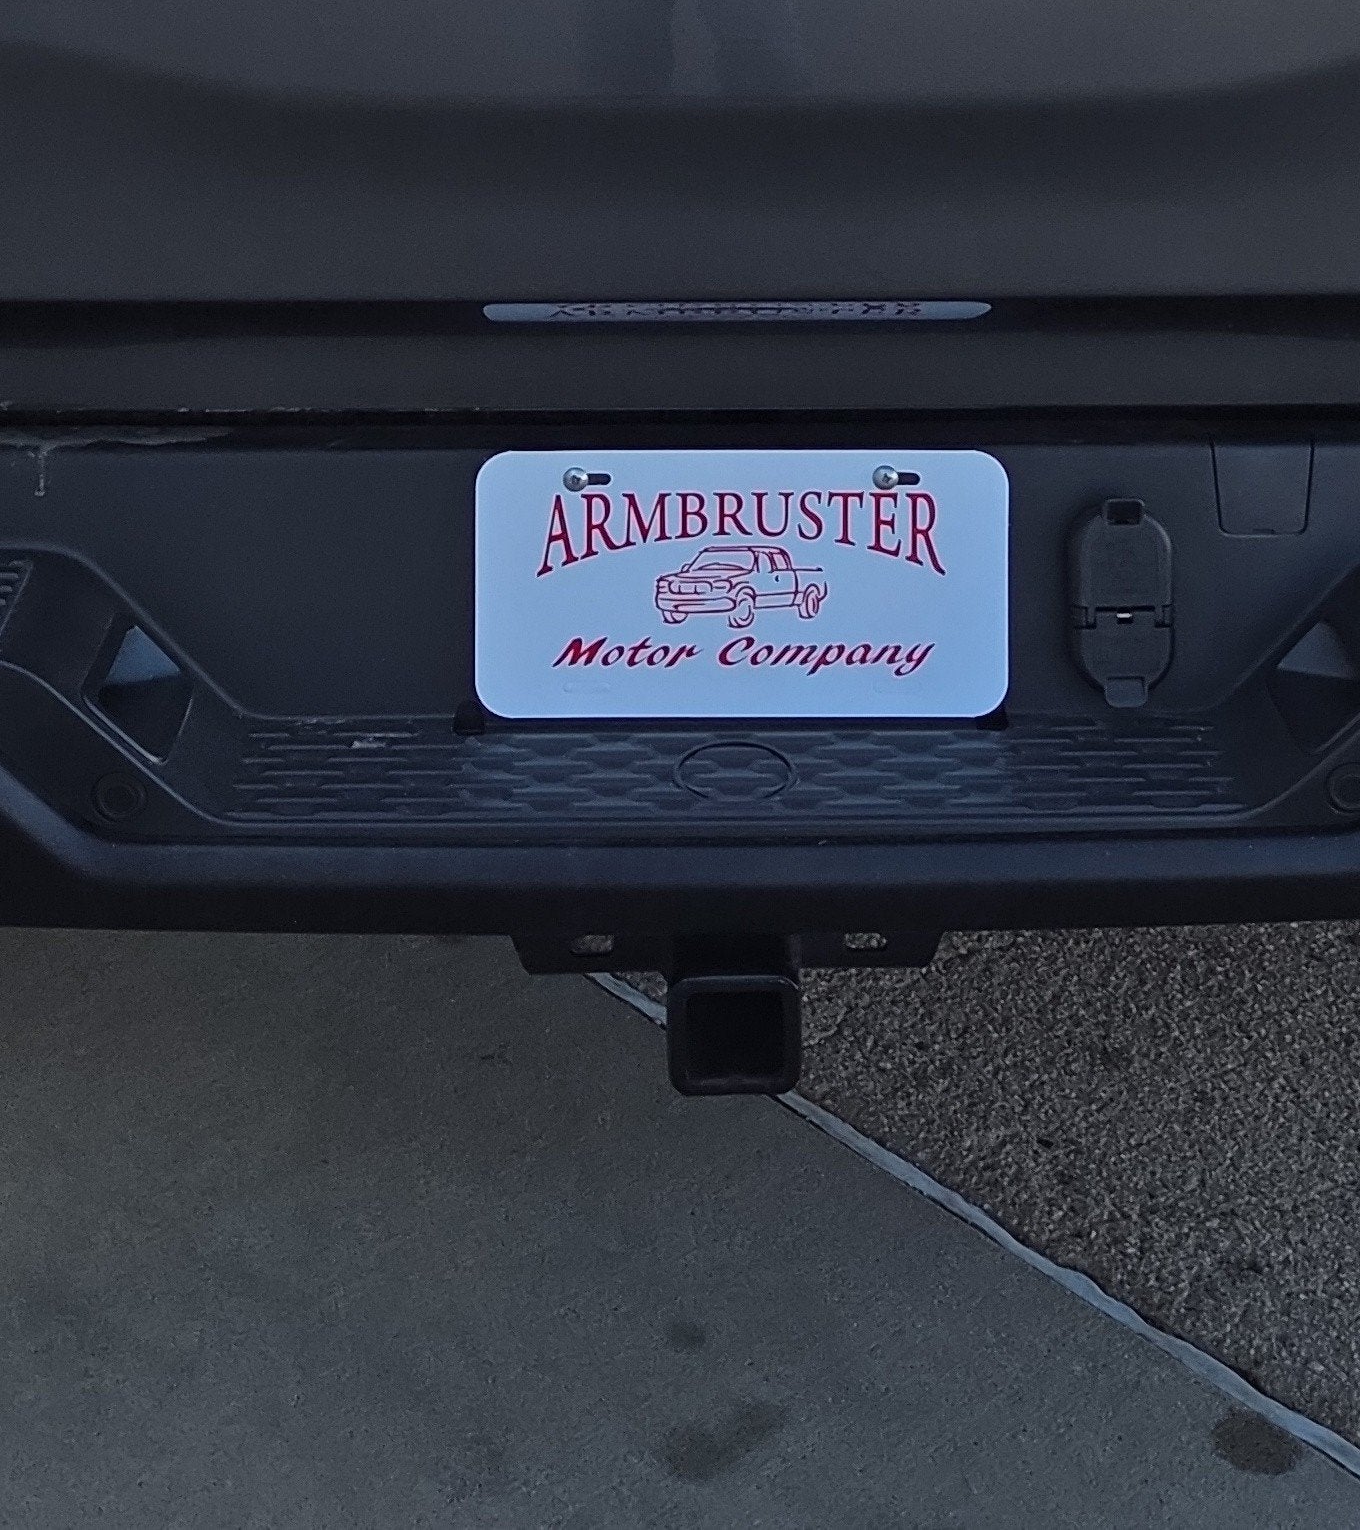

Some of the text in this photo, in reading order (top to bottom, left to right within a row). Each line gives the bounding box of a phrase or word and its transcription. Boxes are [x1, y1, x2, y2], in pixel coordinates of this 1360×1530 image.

[536, 490, 946, 577] ARMBRUSTER
[552, 636, 935, 677] Motor Company
